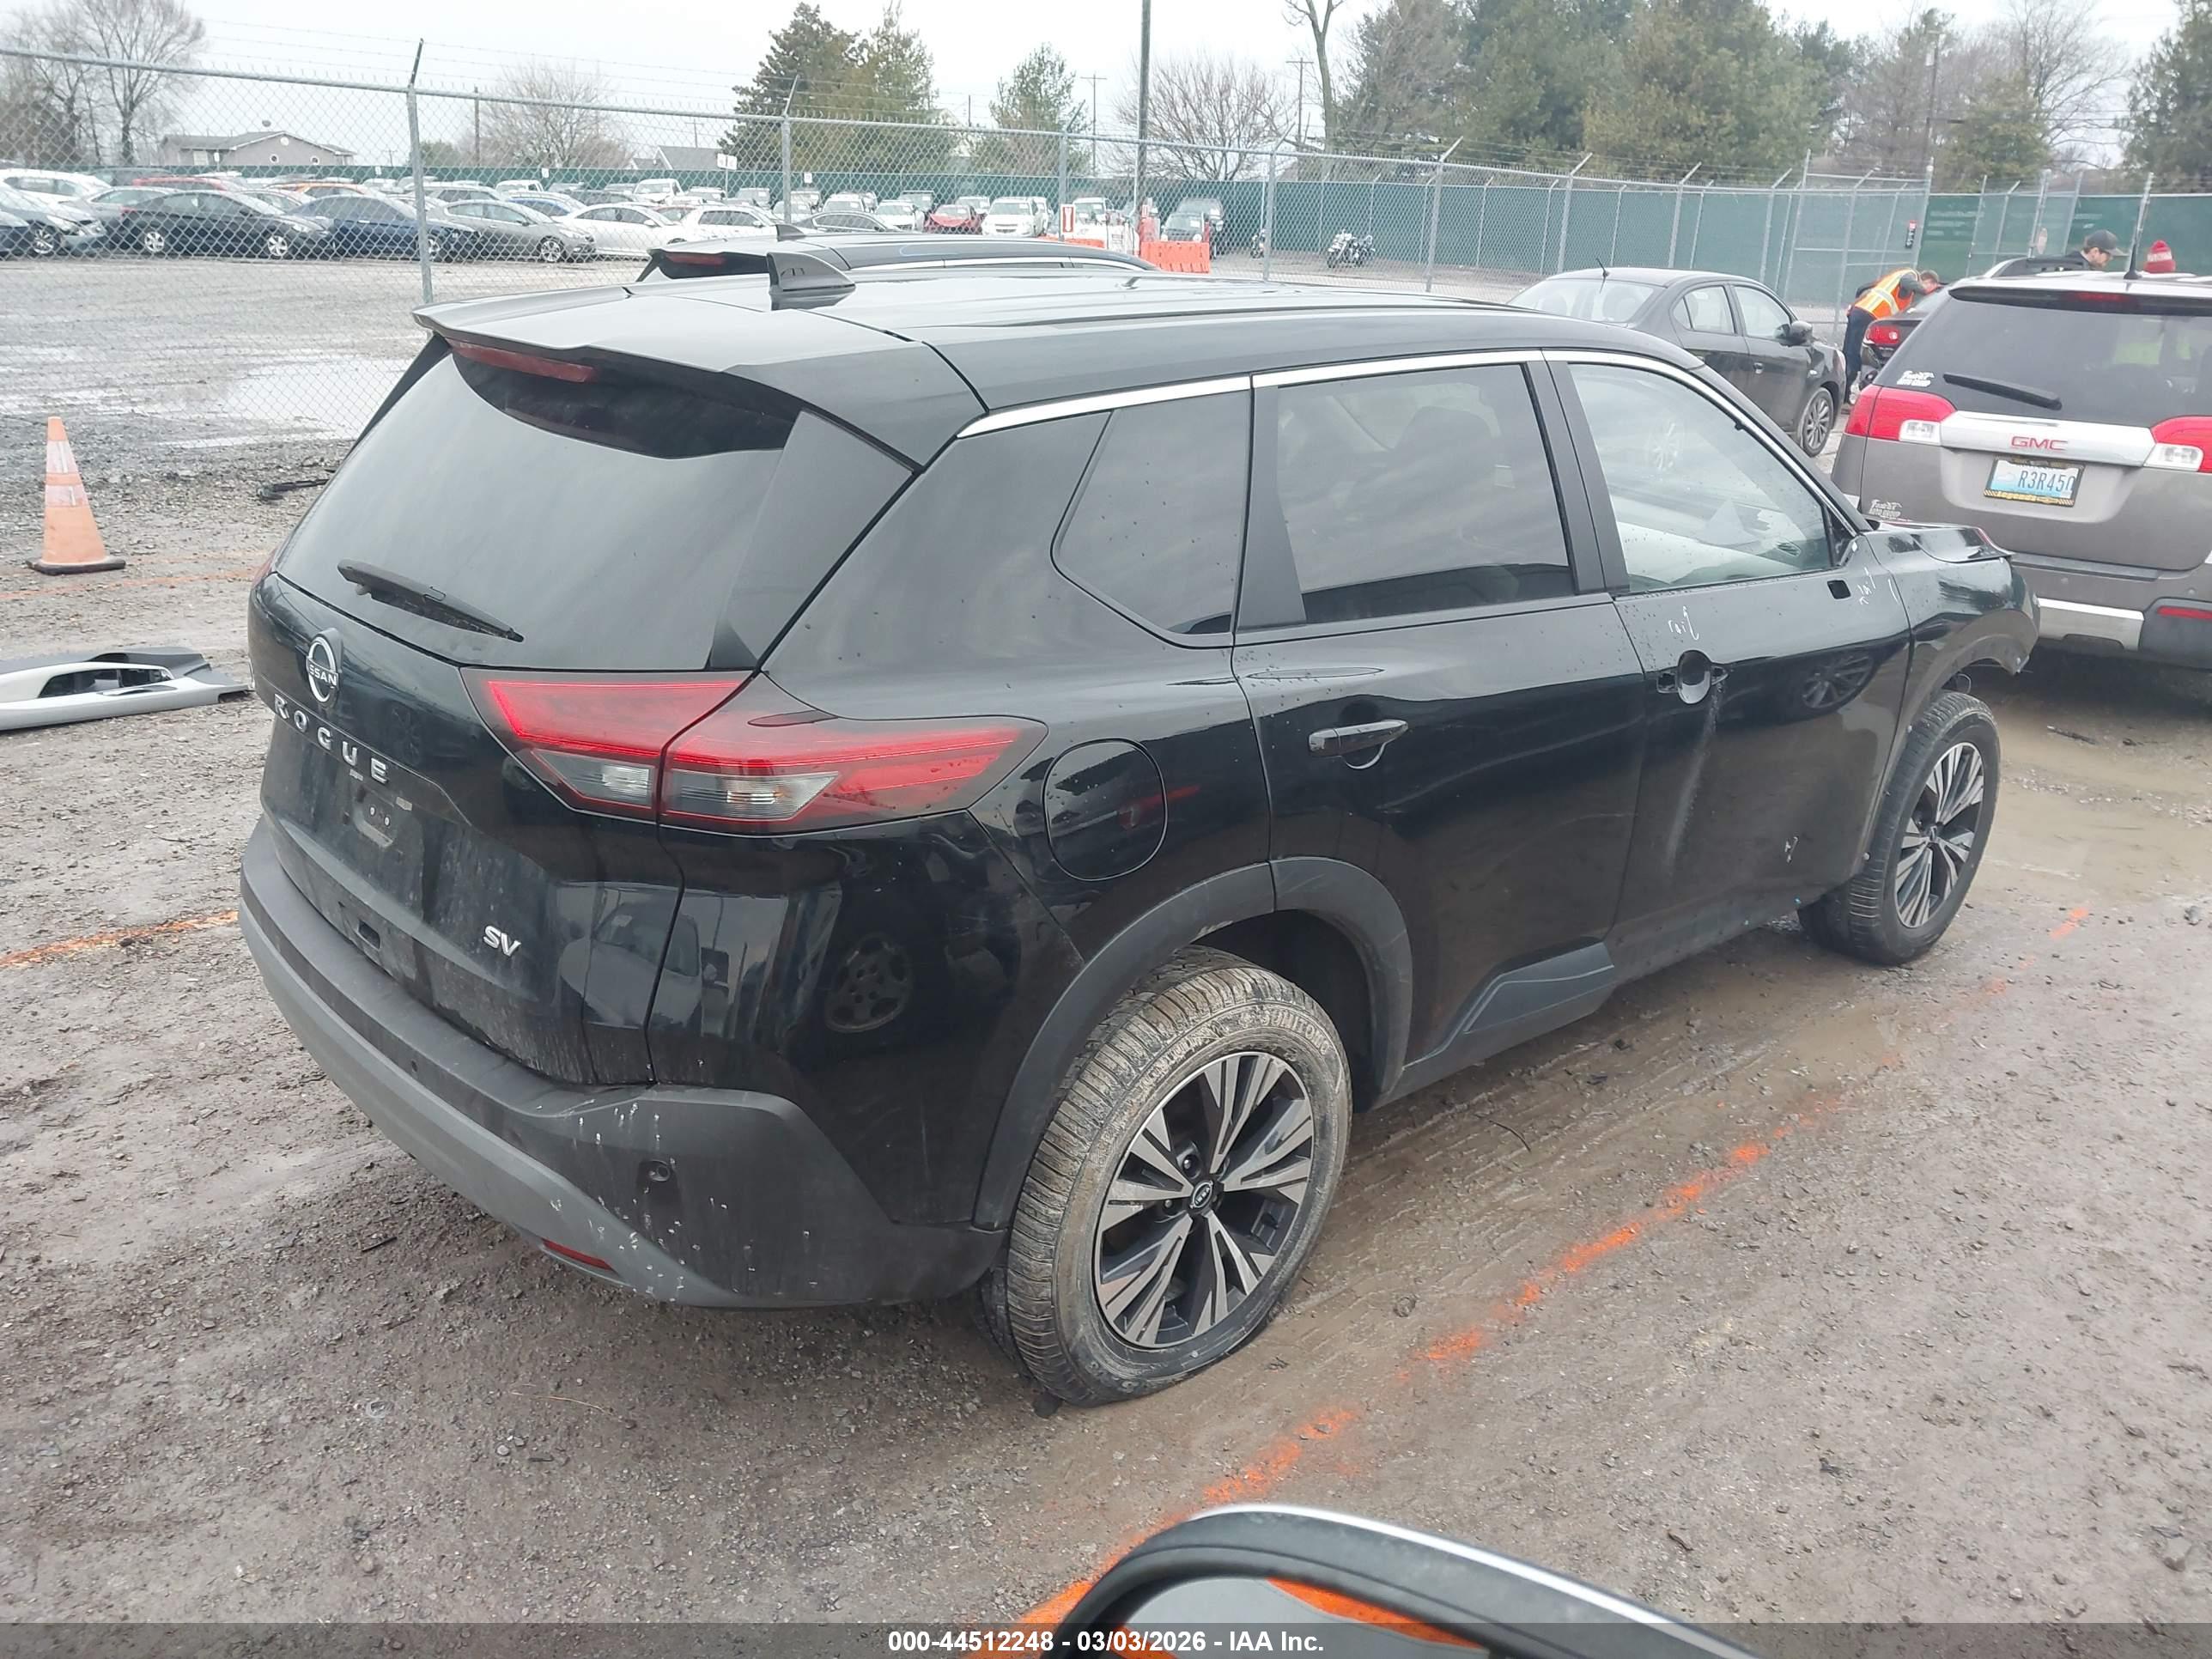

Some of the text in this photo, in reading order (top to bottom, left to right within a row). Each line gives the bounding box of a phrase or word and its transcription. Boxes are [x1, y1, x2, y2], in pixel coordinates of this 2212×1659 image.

[2011, 435, 2069, 452] GMC
[274, 693, 389, 784] ROGUE
[483, 925, 522, 957] SV
